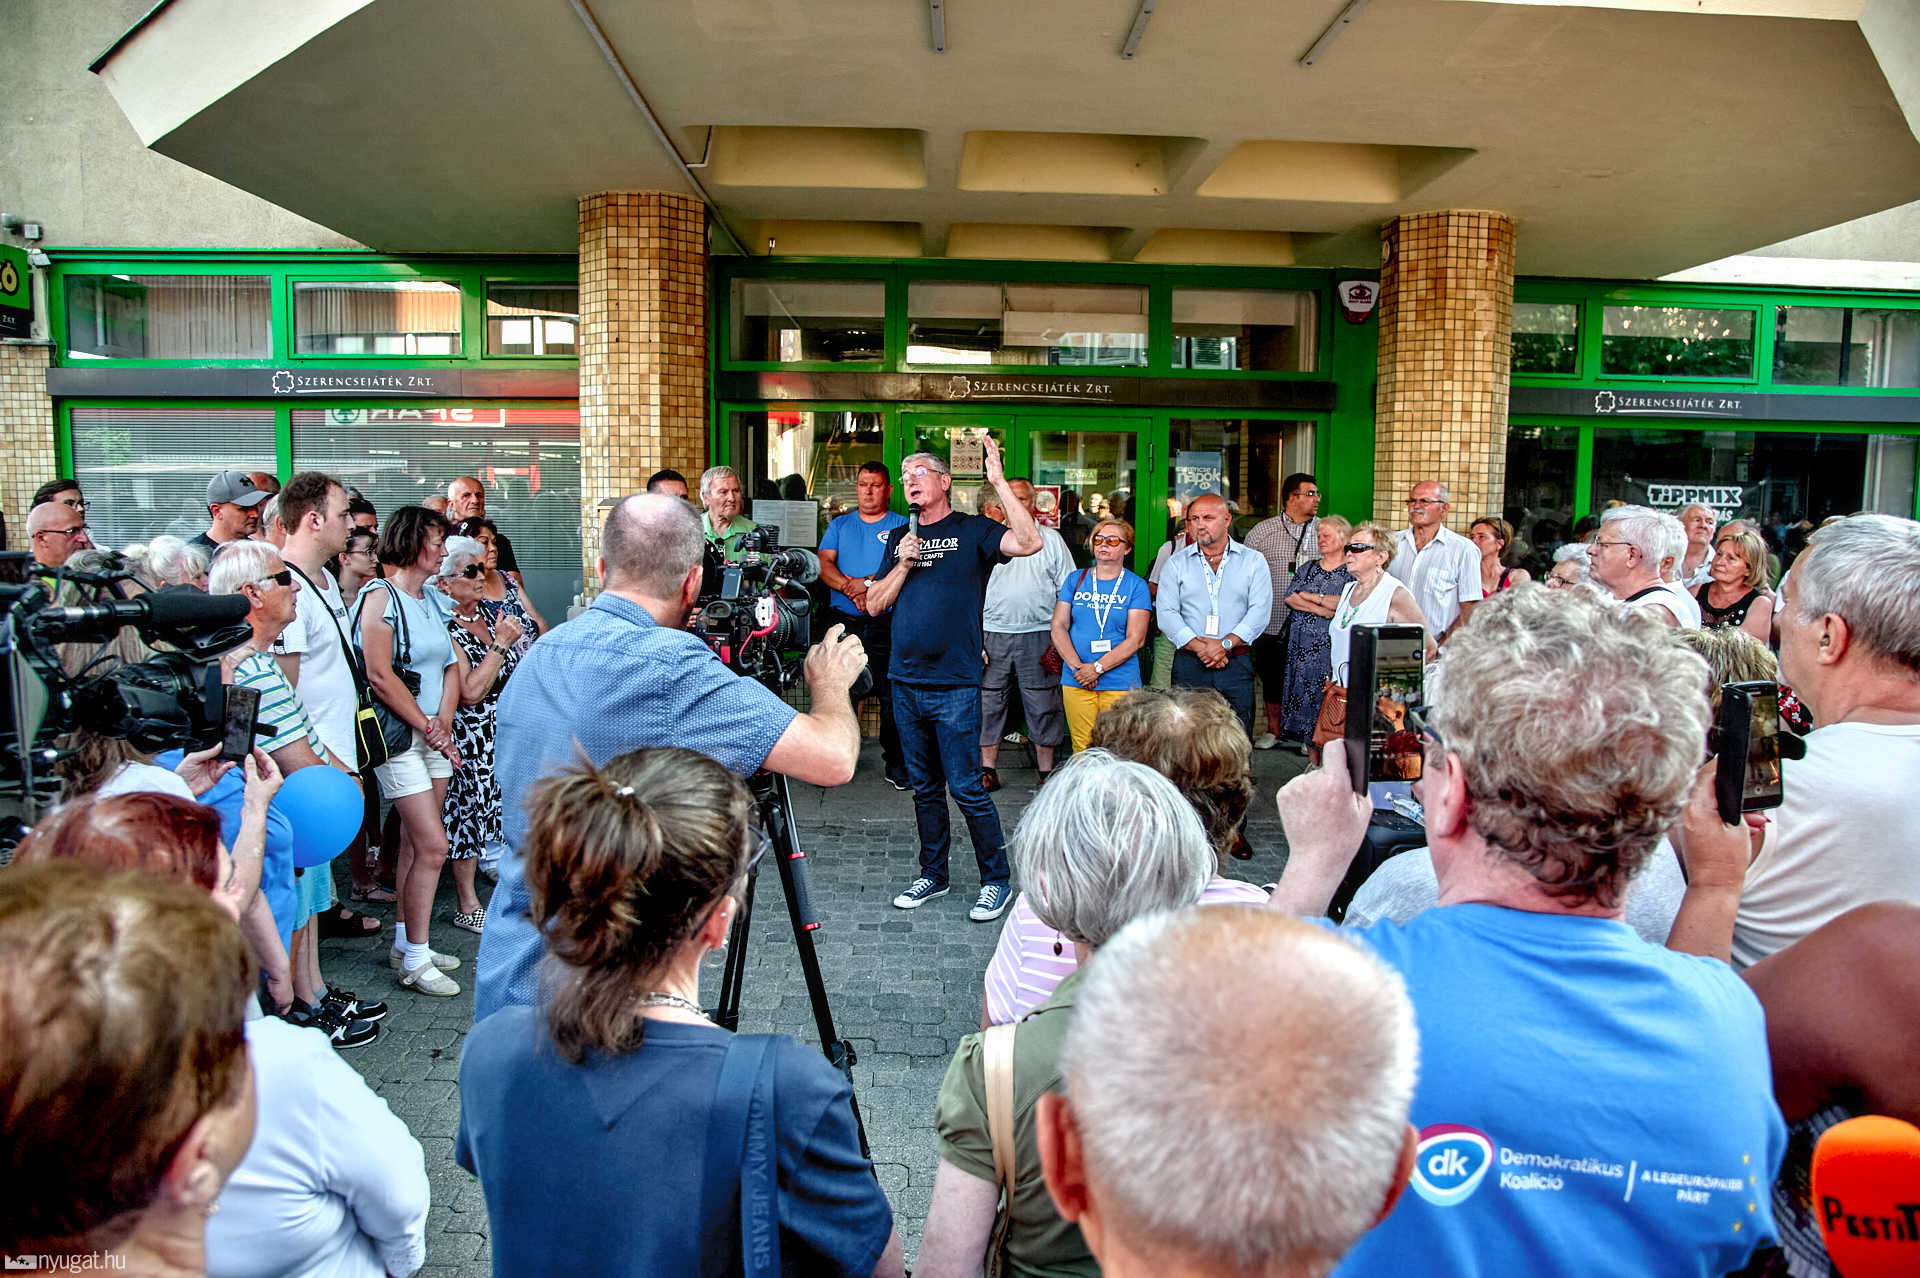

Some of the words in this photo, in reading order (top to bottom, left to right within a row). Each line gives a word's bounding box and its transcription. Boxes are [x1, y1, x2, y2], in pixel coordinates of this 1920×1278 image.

[297, 375, 402, 387] SZERENCSEJÁTÉK
[974, 380, 1081, 393] SZERENCSEJÁTÉK
[1618, 396, 1714, 409] SZERENCSEJÁTÉK
[919, 537, 959, 550] TAILOR
[1428, 1149, 1469, 1176] dk
[1500, 1147, 1624, 1178] Demokratikus
[752, 1187, 771, 1271] JEANS
